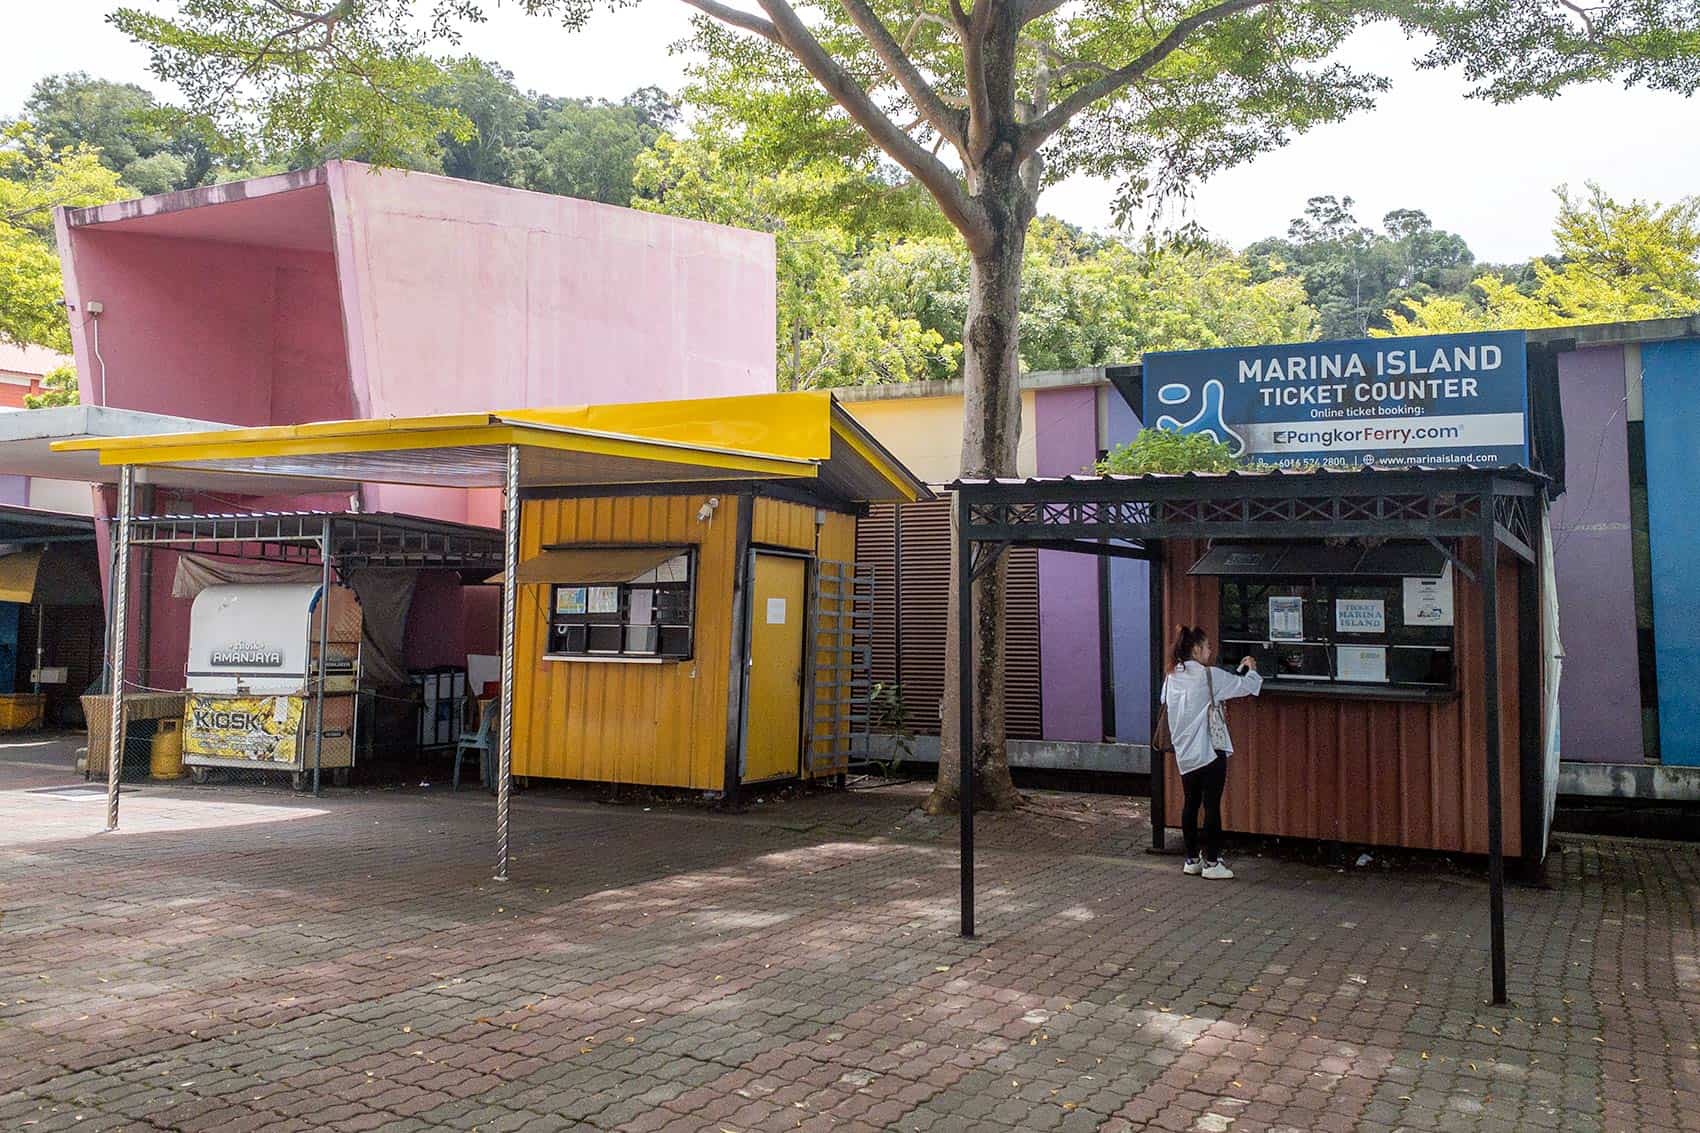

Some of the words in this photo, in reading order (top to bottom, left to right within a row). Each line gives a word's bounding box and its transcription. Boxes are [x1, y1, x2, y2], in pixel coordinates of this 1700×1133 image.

[1238, 352, 1366, 384] MARINA
[1376, 345, 1502, 376] ISLAND
[1259, 384, 1347, 407] TICKET
[1354, 377, 1478, 402] COUNTER
[1310, 407, 1344, 419] Online
[1346, 406, 1376, 417] ticket
[1378, 404, 1425, 417] booking:
[1322, 455, 1346, 466] 2800
[1379, 453, 1498, 465] www.marinaisland.com
[213, 652, 280, 664] AMANJAYA
[194, 710, 260, 732] KIOSK
